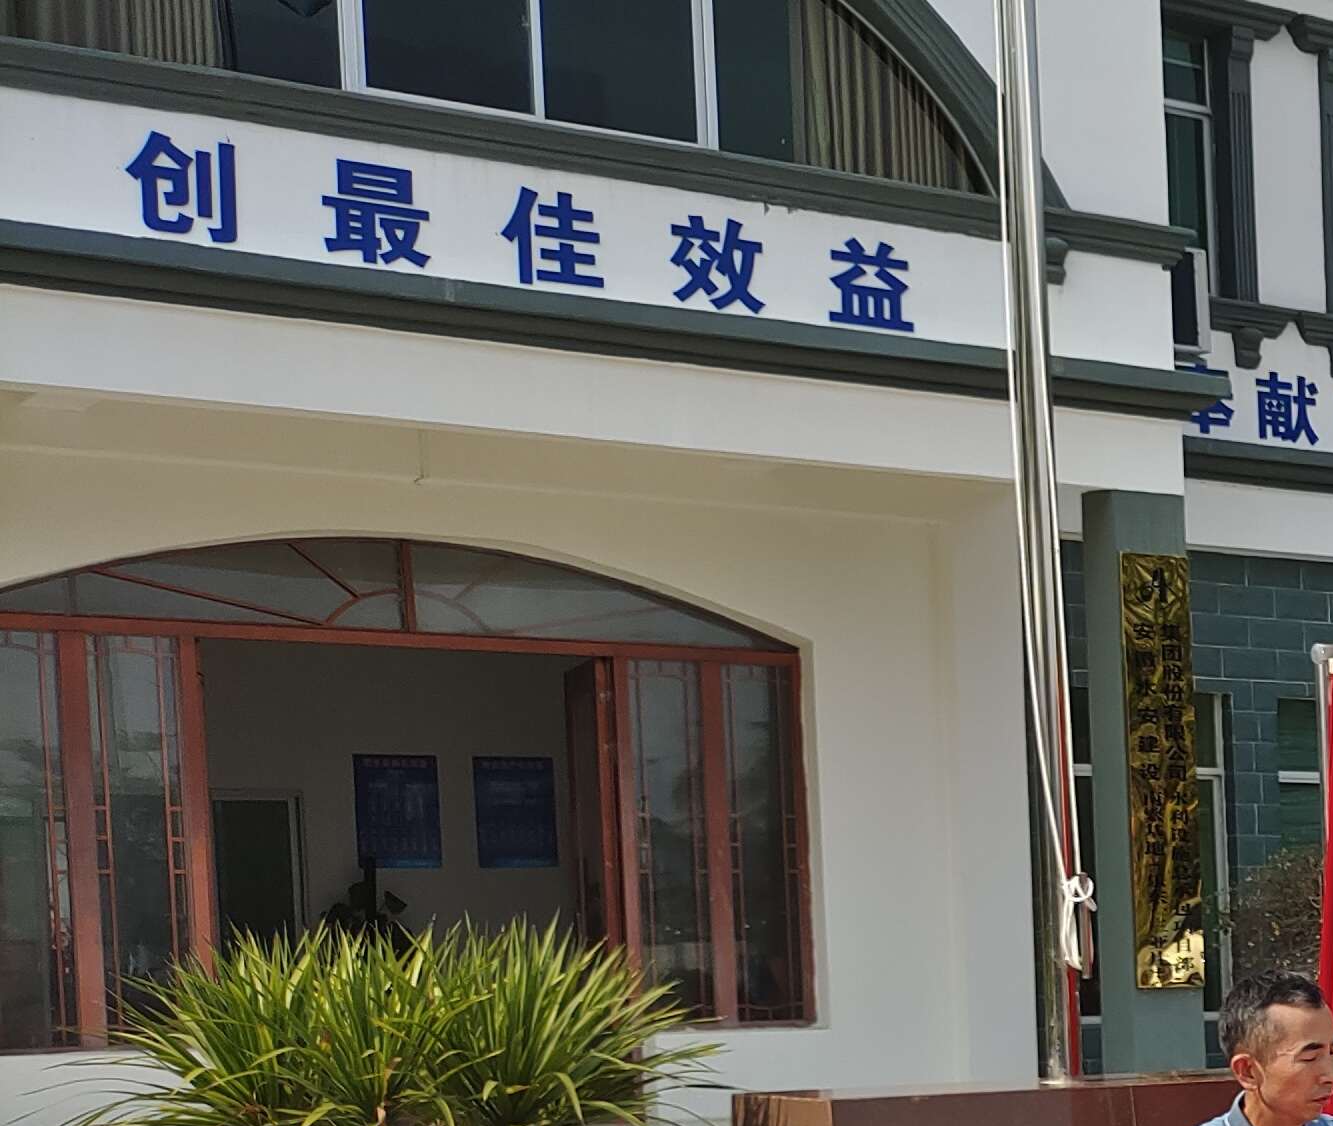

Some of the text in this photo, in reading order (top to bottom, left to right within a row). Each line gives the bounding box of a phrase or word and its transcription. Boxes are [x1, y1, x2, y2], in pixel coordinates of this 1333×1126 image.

[126, 130, 915, 332] 创最佳效益
